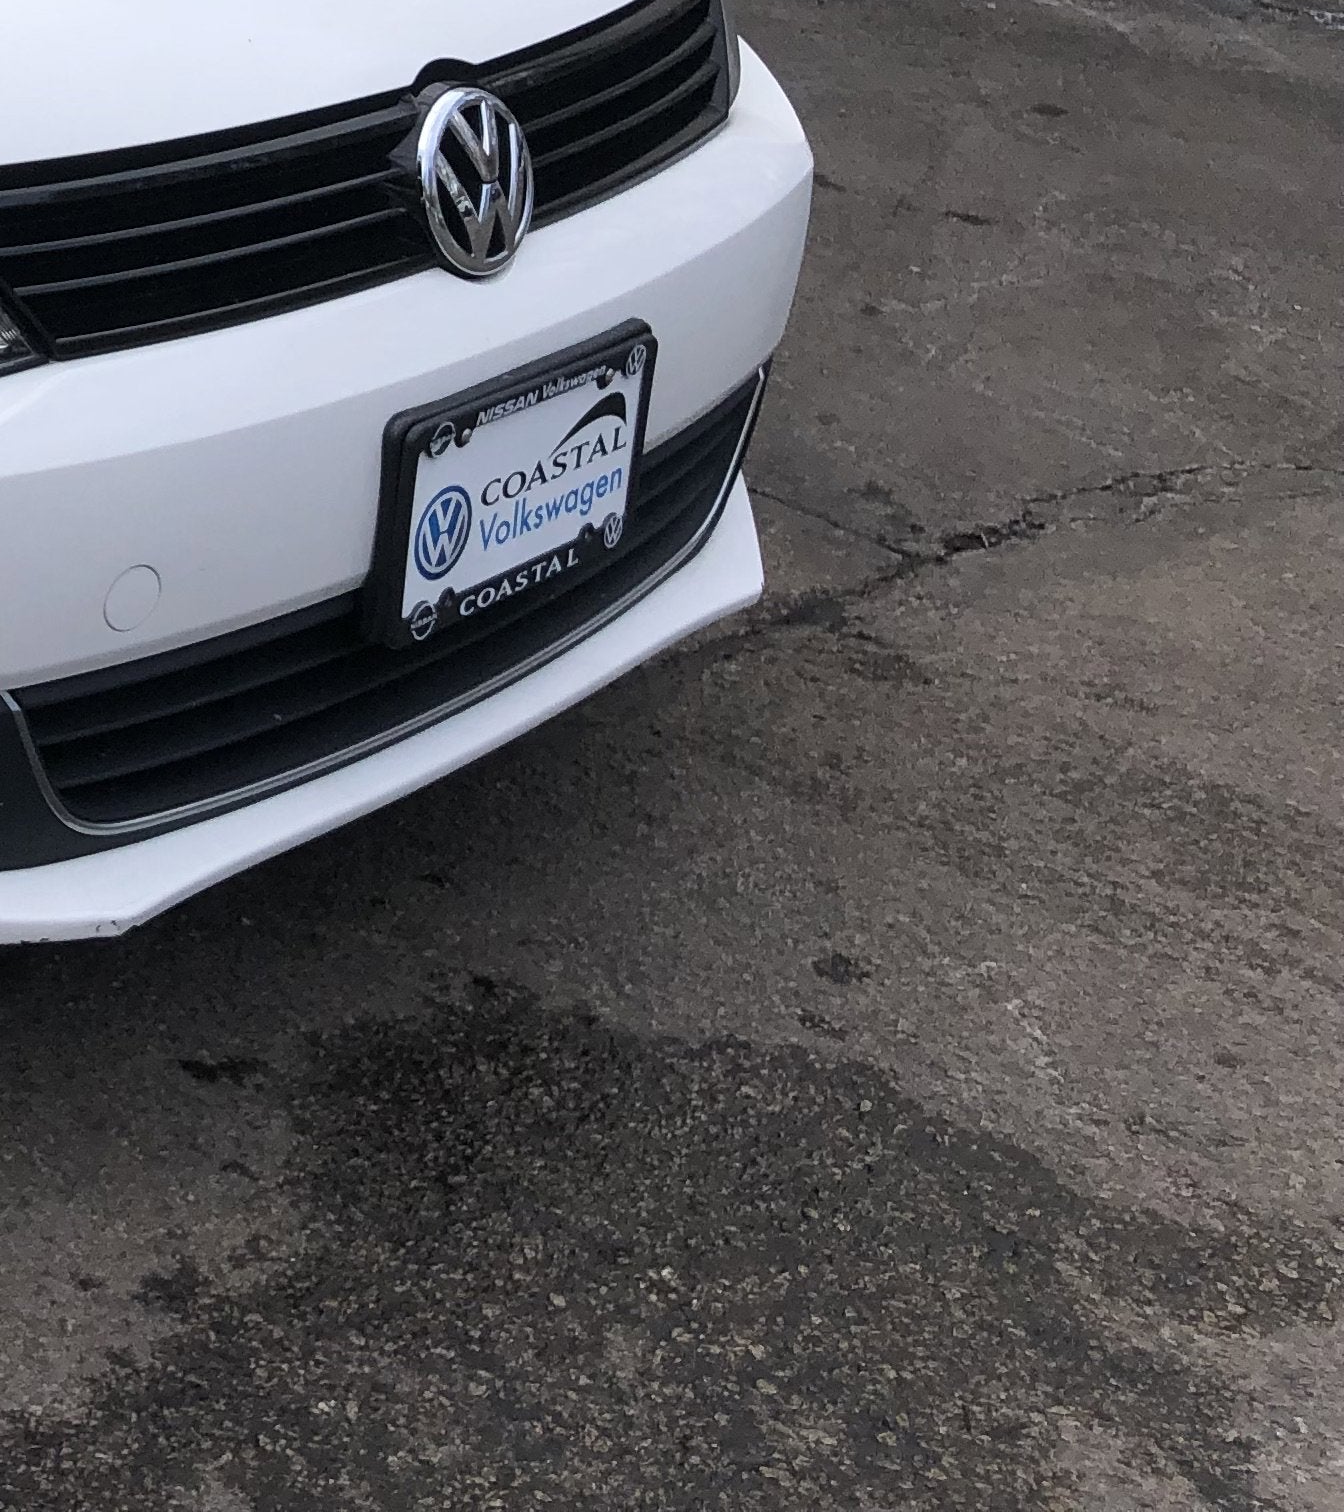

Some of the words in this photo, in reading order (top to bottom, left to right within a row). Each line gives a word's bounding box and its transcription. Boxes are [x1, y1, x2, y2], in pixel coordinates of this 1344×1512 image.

[476, 388, 539, 426] NISSAN
[541, 365, 607, 398] Volkswagen
[480, 426, 627, 507] COASTAL
[479, 467, 623, 552] Volkswagen
[459, 548, 579, 617] COASTAL
